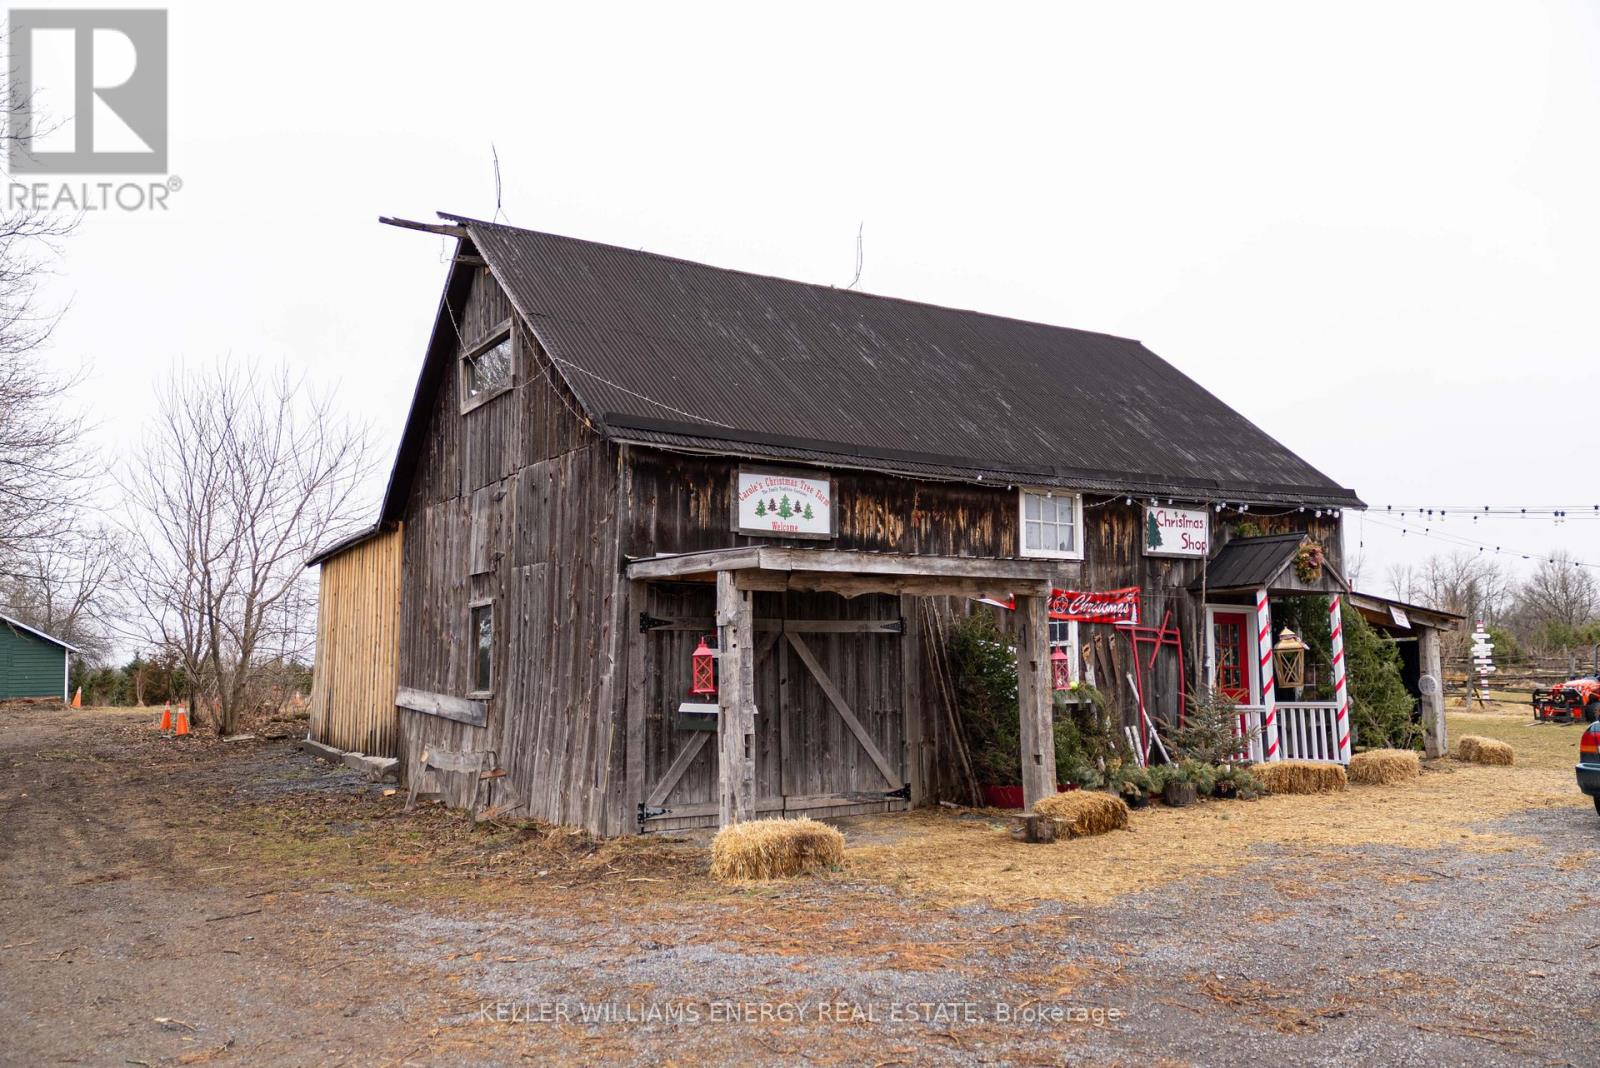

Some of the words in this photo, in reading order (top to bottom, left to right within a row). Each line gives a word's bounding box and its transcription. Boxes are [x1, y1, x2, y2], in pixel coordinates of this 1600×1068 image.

[738, 481, 763, 501] Carole's
[765, 477, 797, 487] Christmas
[800, 480, 814, 494] Tree
[815, 489, 832, 506] Farm
[771, 521, 799, 534] Welcome
[1156, 510, 1204, 528] Christmas
[1181, 532, 1207, 555] Shop
[1069, 594, 1129, 615] Christmas
